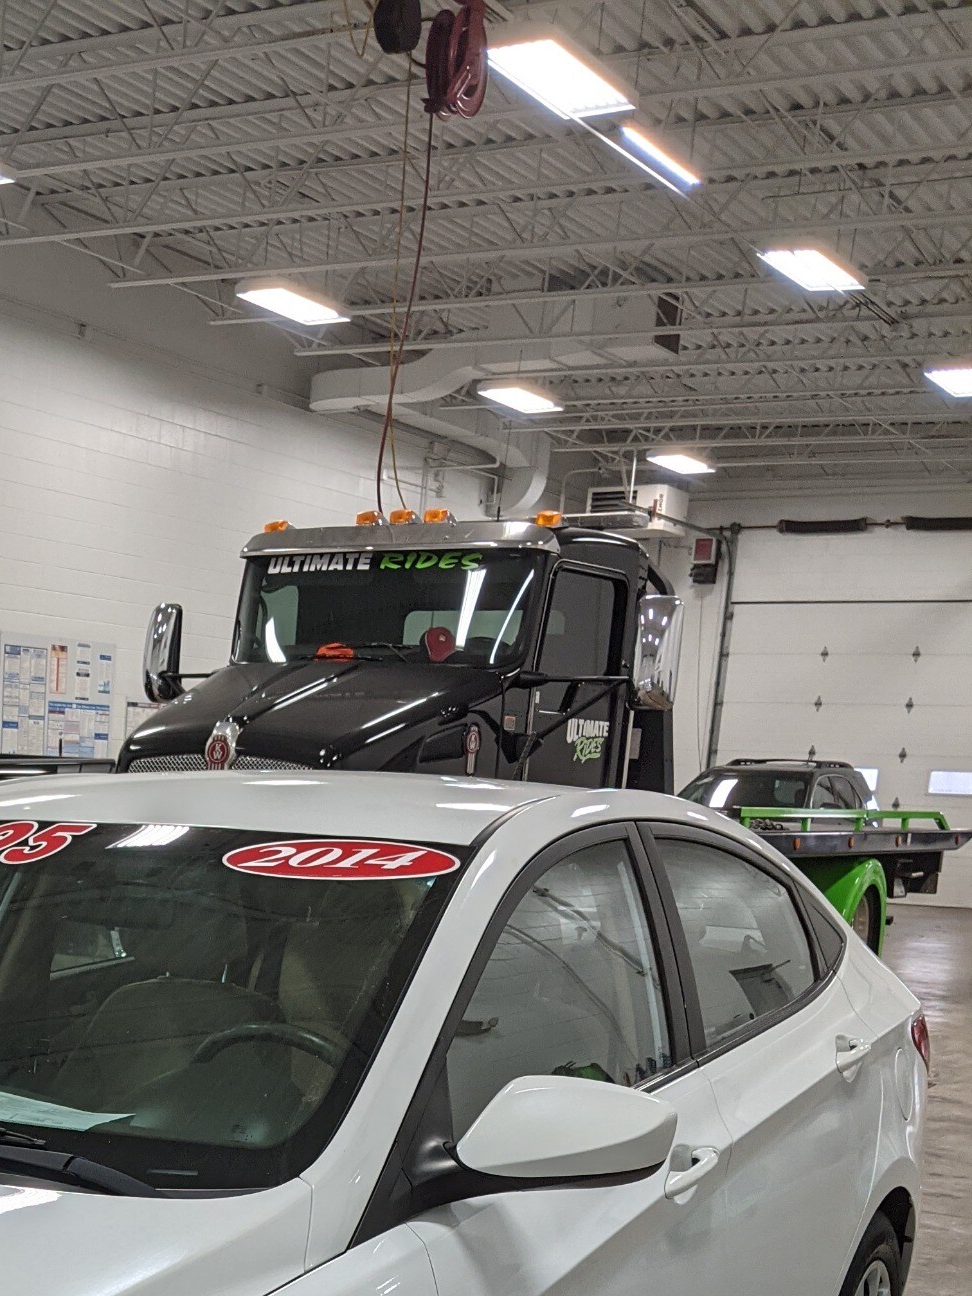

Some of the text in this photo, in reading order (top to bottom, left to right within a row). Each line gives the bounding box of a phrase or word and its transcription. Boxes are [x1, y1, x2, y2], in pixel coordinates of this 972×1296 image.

[267, 552, 483, 574] ULTIMATE RIDES
[566, 718, 610, 744] ULTIMATE
[237, 846, 428, 870] 2014
